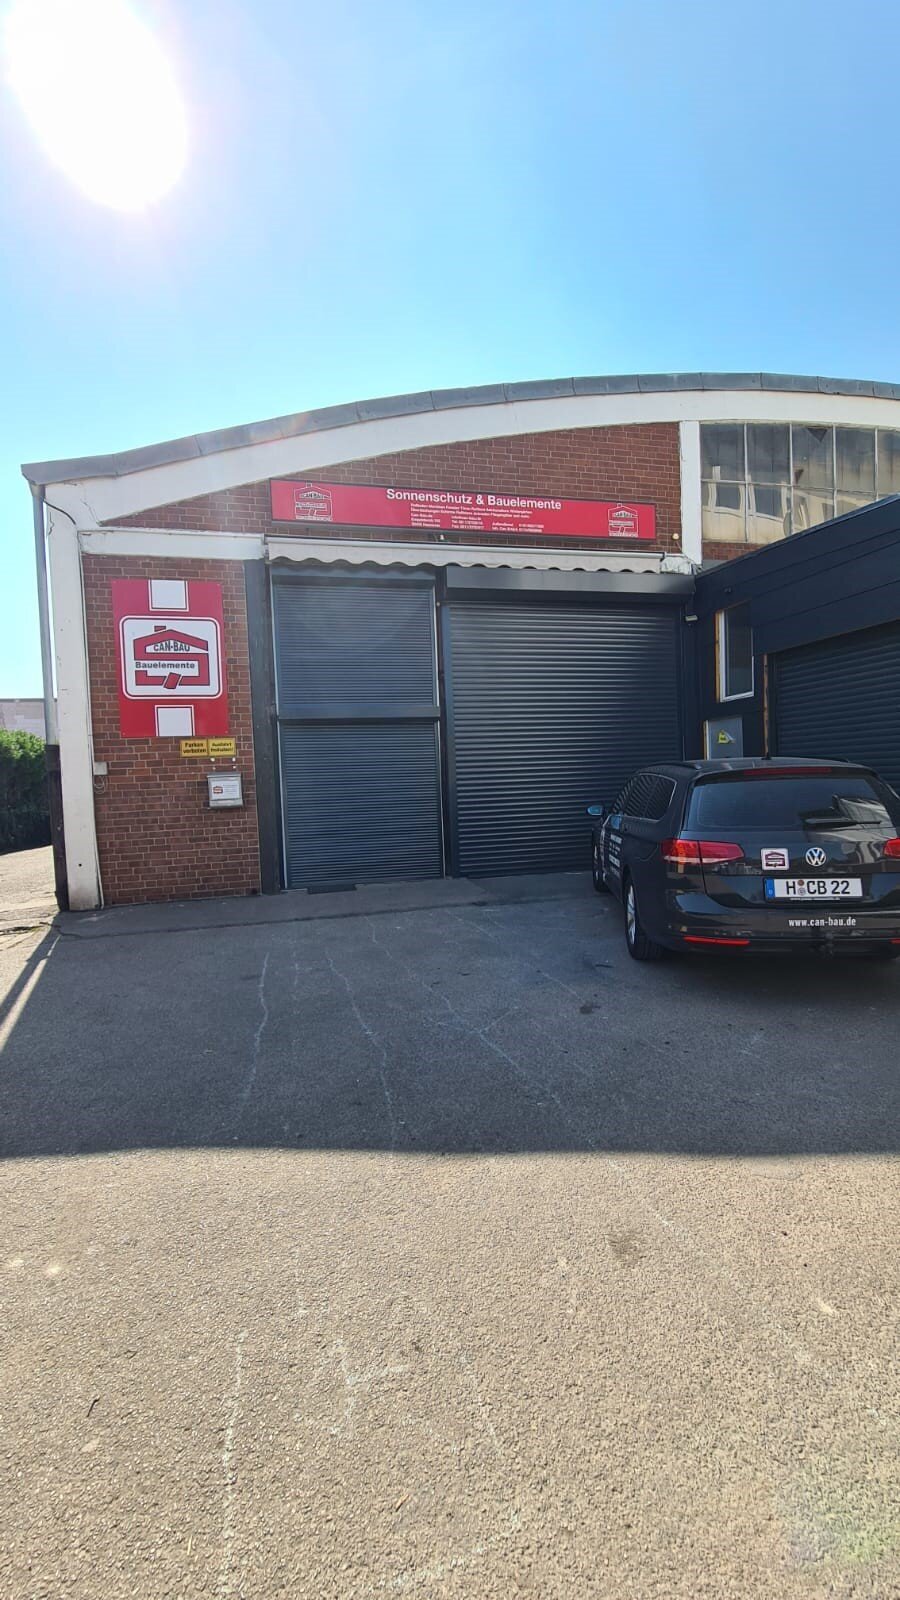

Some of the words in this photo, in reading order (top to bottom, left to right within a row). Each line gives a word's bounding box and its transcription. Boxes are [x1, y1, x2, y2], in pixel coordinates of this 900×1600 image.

[386, 488, 473, 505] Sonnenschutz
[476, 494, 484, 505] &
[487, 495, 562, 510] Bauelemente
[153, 641, 190, 652] CAN-BAU
[135, 661, 195, 669] Bauelemente
[788, 916, 857, 927] www.can-bau.de
